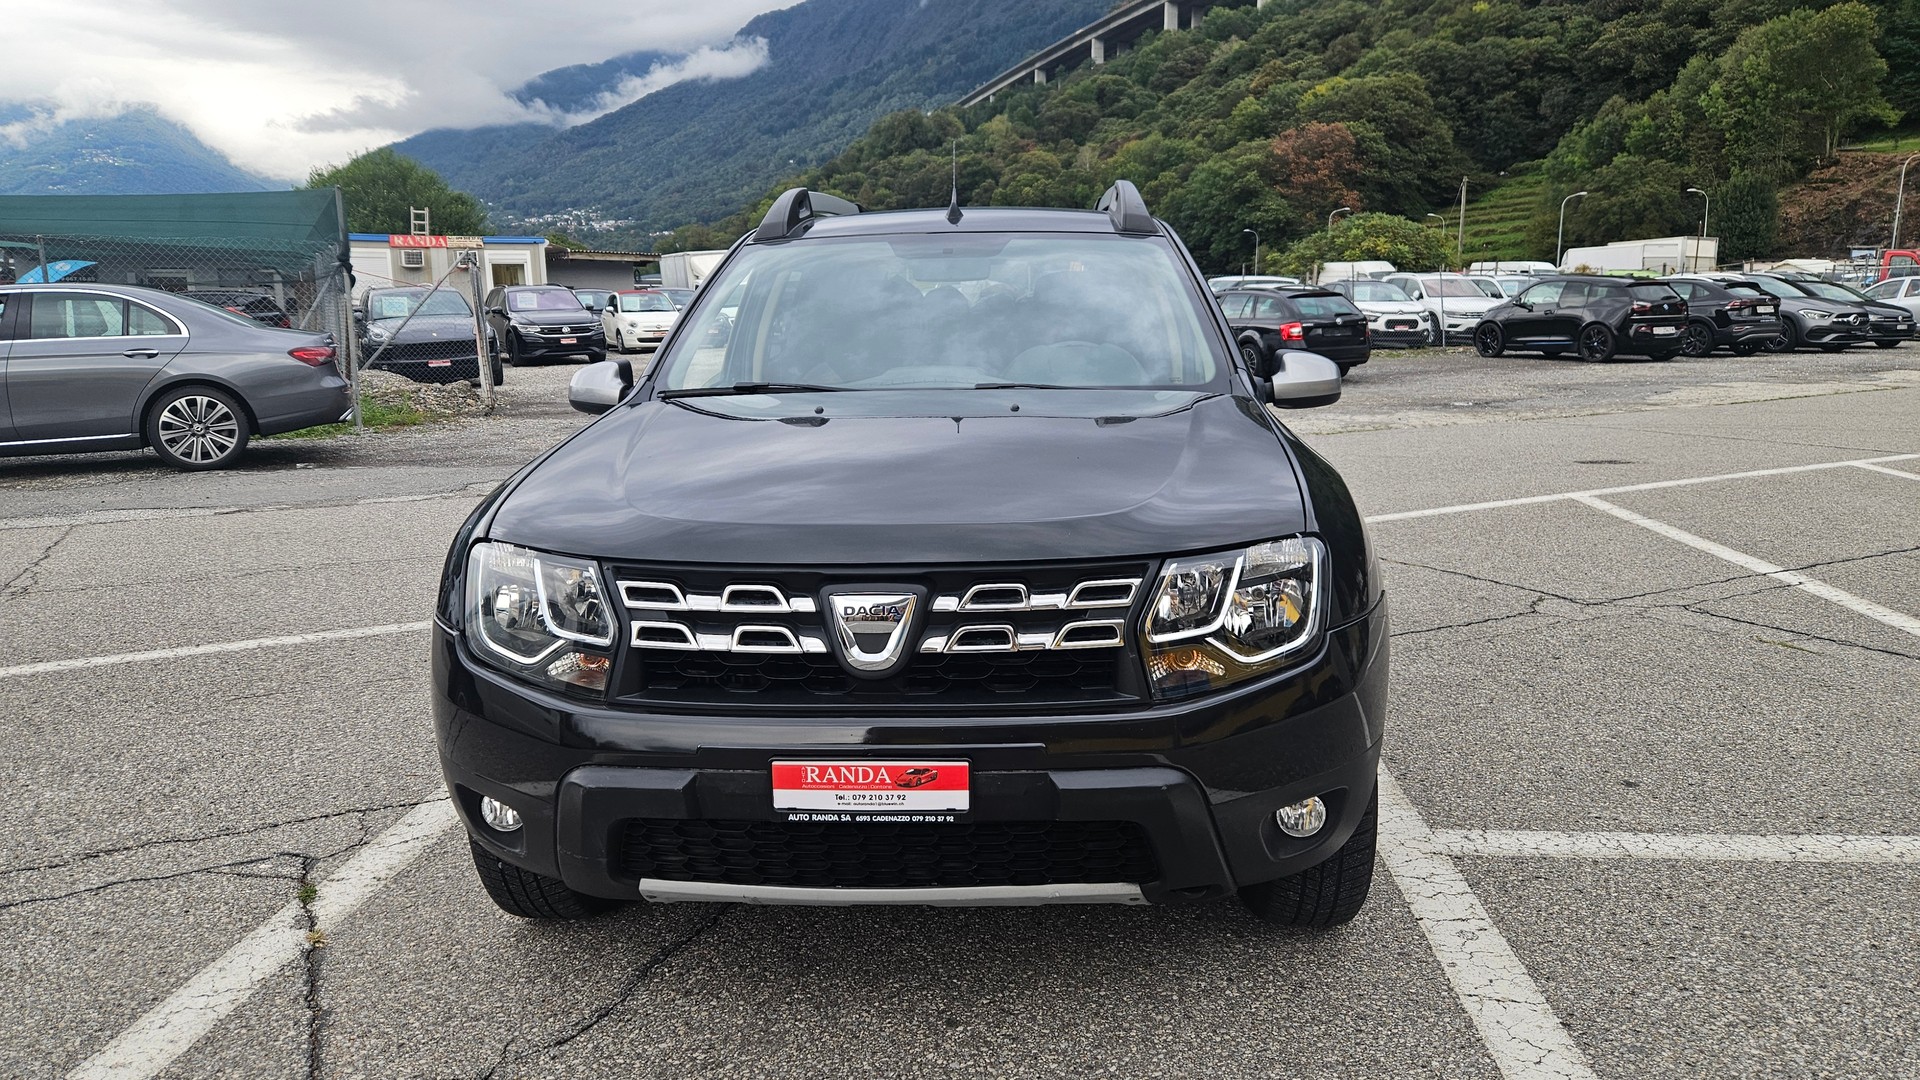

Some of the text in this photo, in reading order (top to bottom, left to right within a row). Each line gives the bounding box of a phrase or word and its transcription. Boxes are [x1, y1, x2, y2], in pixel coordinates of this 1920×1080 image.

[393, 235, 447, 246] RANDA
[844, 605, 901, 616] DACIA
[805, 766, 892, 783] RANDA
